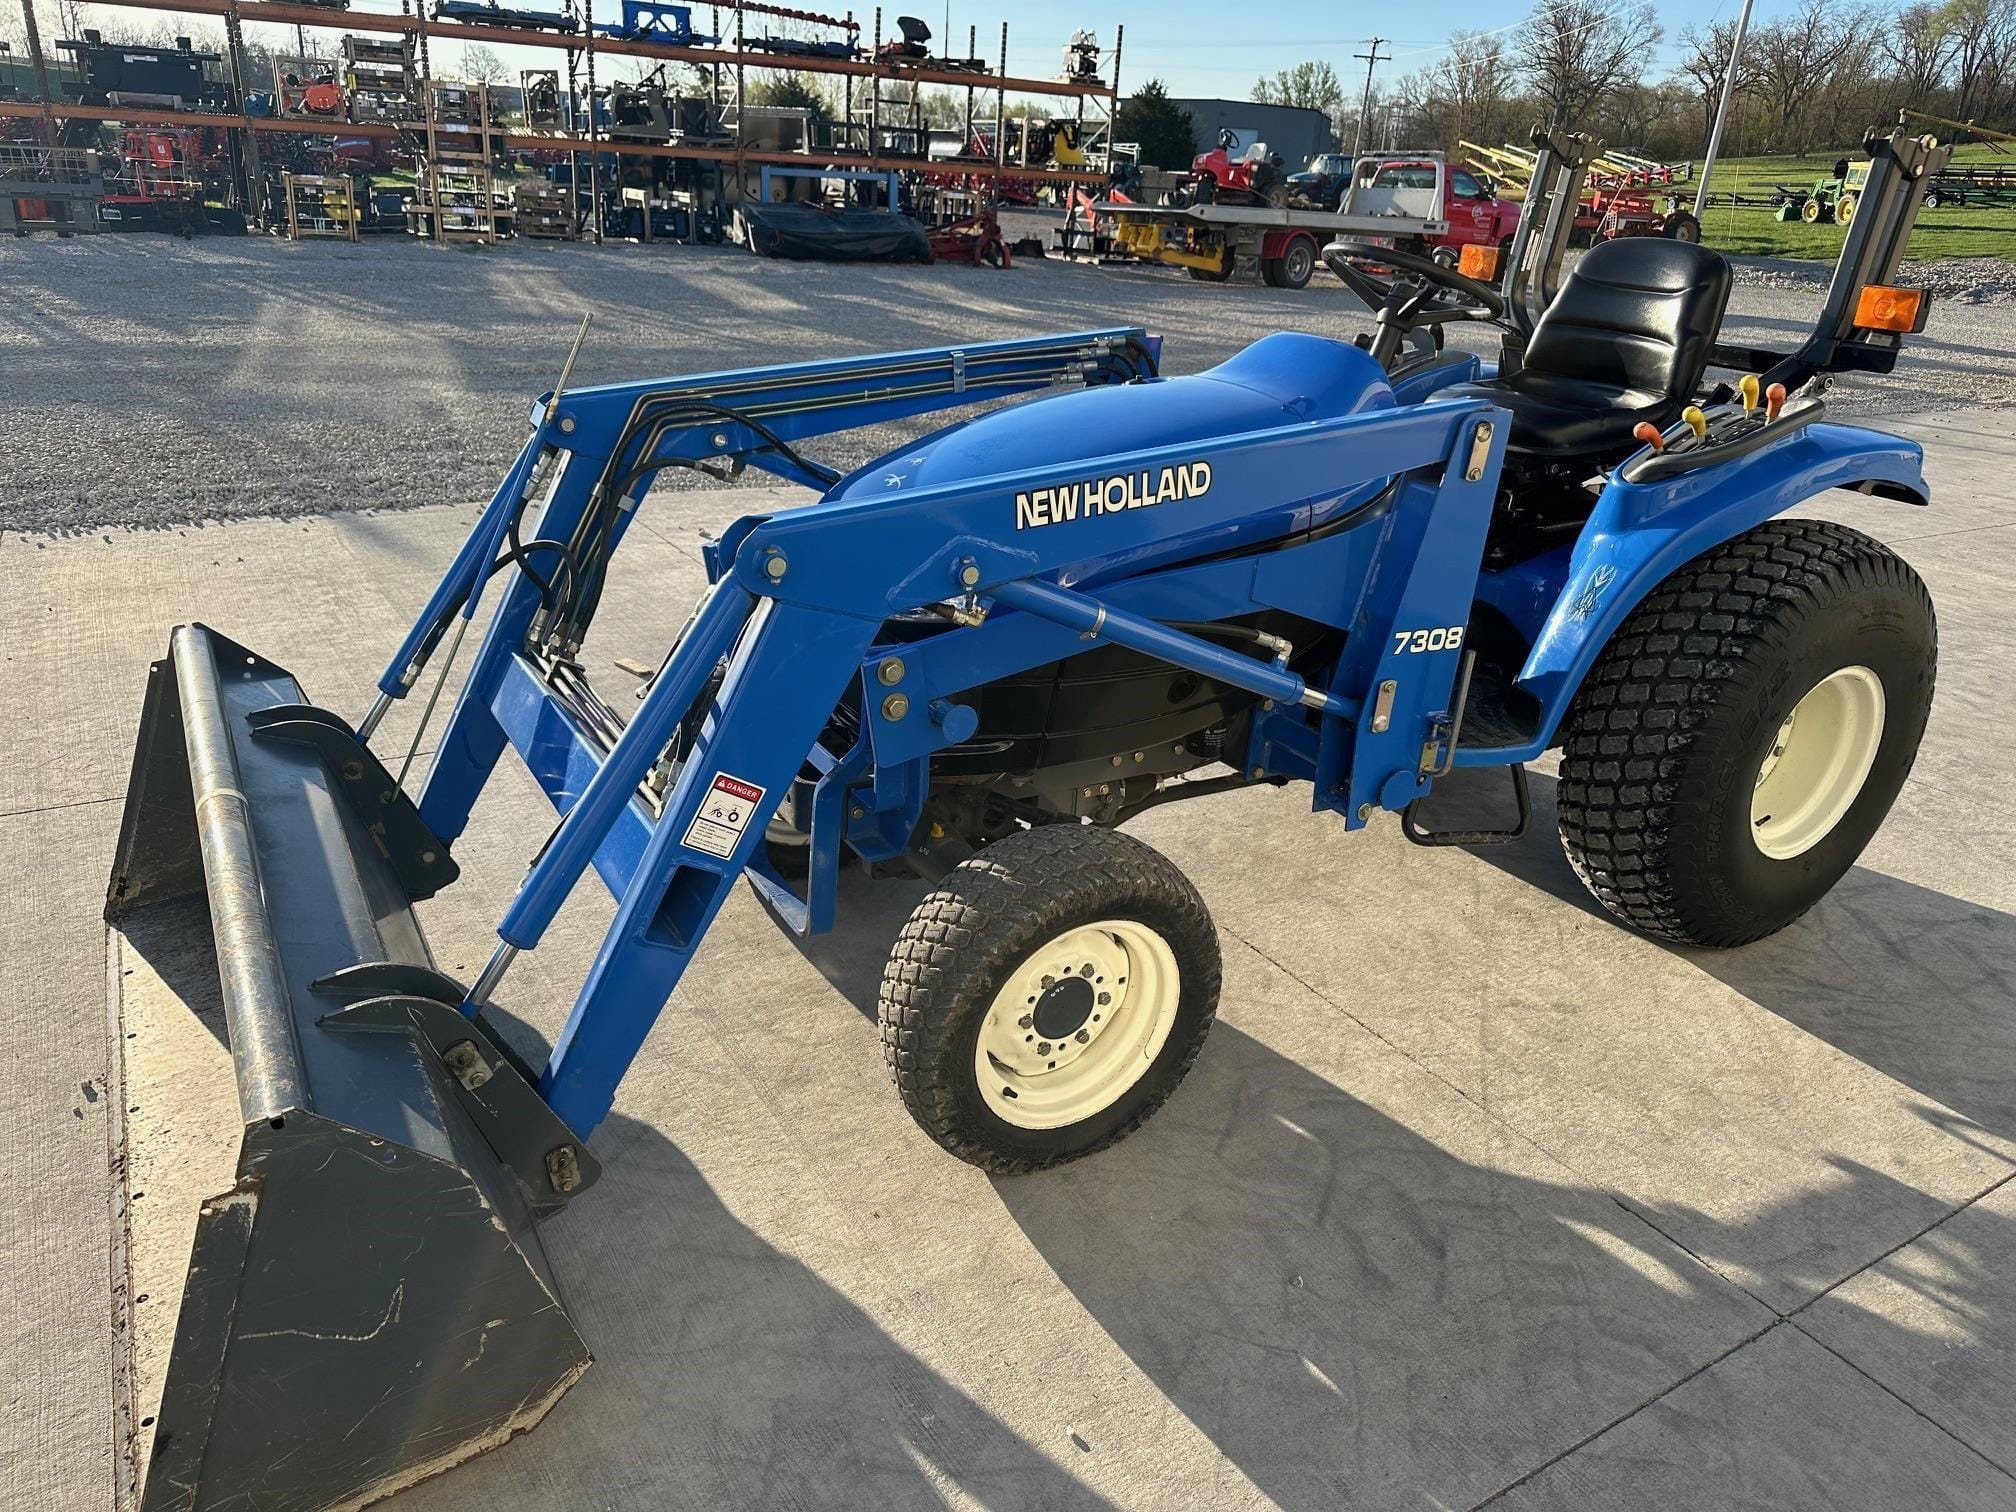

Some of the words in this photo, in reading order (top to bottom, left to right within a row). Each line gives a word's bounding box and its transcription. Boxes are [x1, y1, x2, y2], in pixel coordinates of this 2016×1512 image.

[1016, 484, 1079, 530] NEW
[1084, 461, 1212, 516] HOLLAND
[1393, 626, 1464, 655] 7308
[726, 782, 758, 799] DANGER
